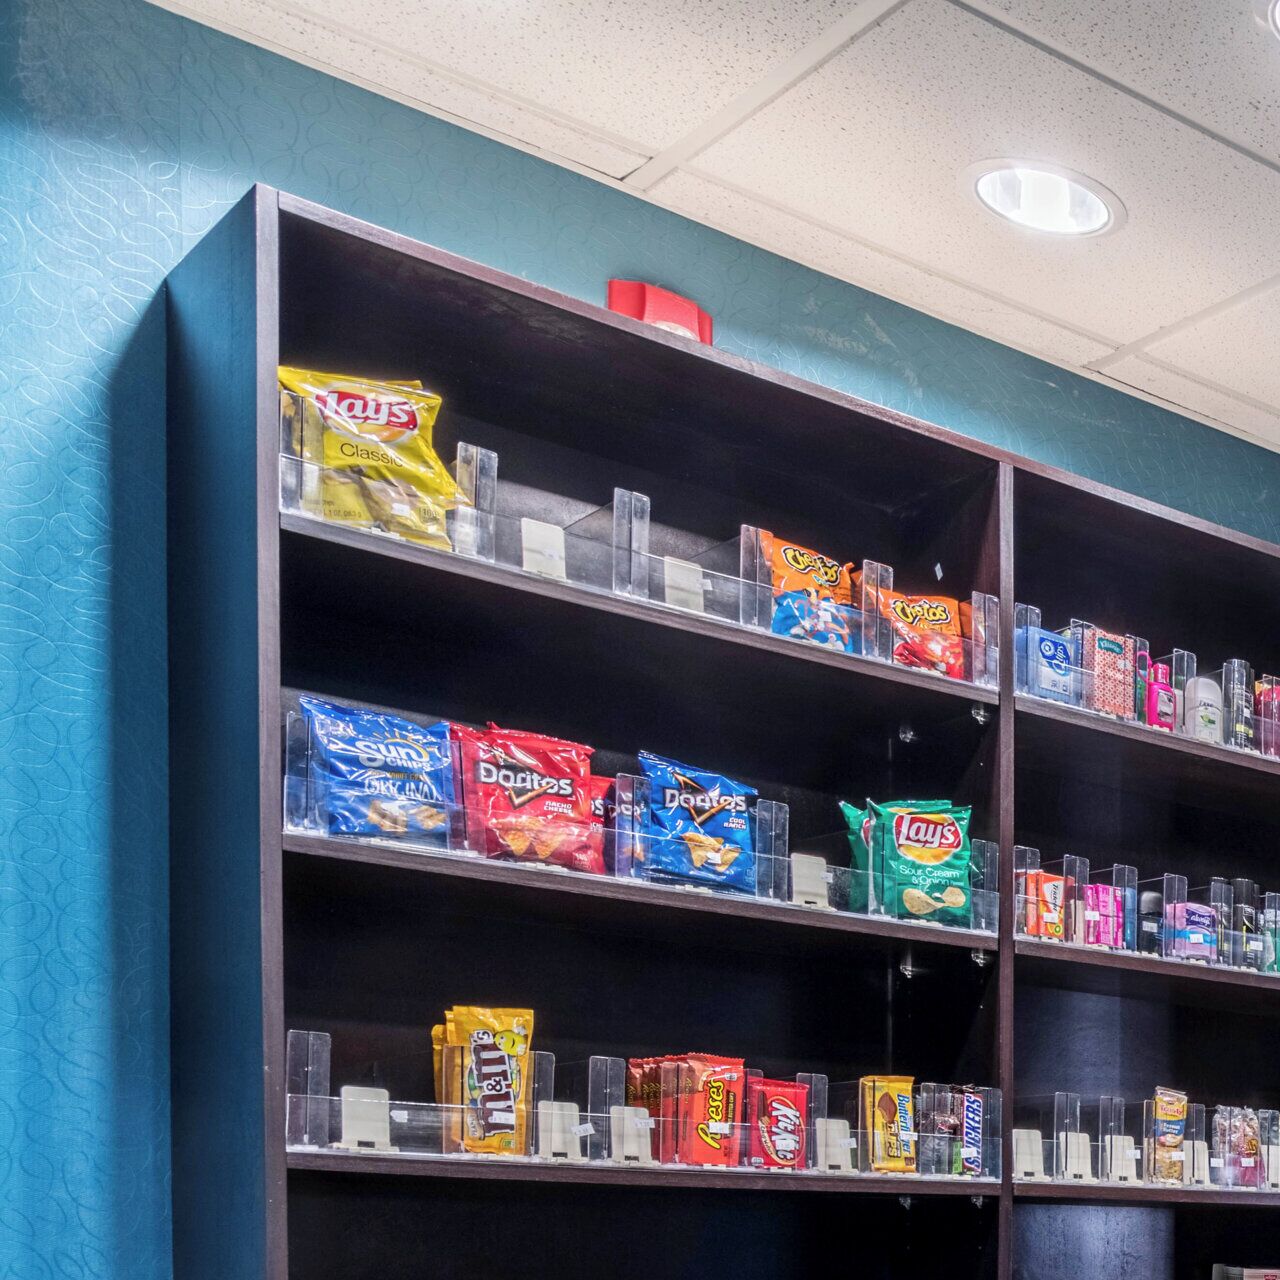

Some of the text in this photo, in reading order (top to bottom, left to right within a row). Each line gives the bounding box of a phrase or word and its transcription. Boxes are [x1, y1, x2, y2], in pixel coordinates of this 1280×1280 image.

[340, 442, 404, 468] Classic
[893, 600, 949, 624] Chetos
[356, 741, 430, 767] Sun
[387, 757, 432, 772] CHIPS
[480, 761, 573, 795] Doritos
[544, 806, 573, 814] CHEESE
[665, 788, 747, 811] Doritos
[898, 815, 957, 848] Lay's
[900, 865, 960, 878] Sour Cream
[919, 875, 950, 886] Onion
[696, 1078, 725, 1150] Rese's
[896, 1094, 912, 1154] Butterfiger
[965, 1093, 982, 1169] SICKERS
